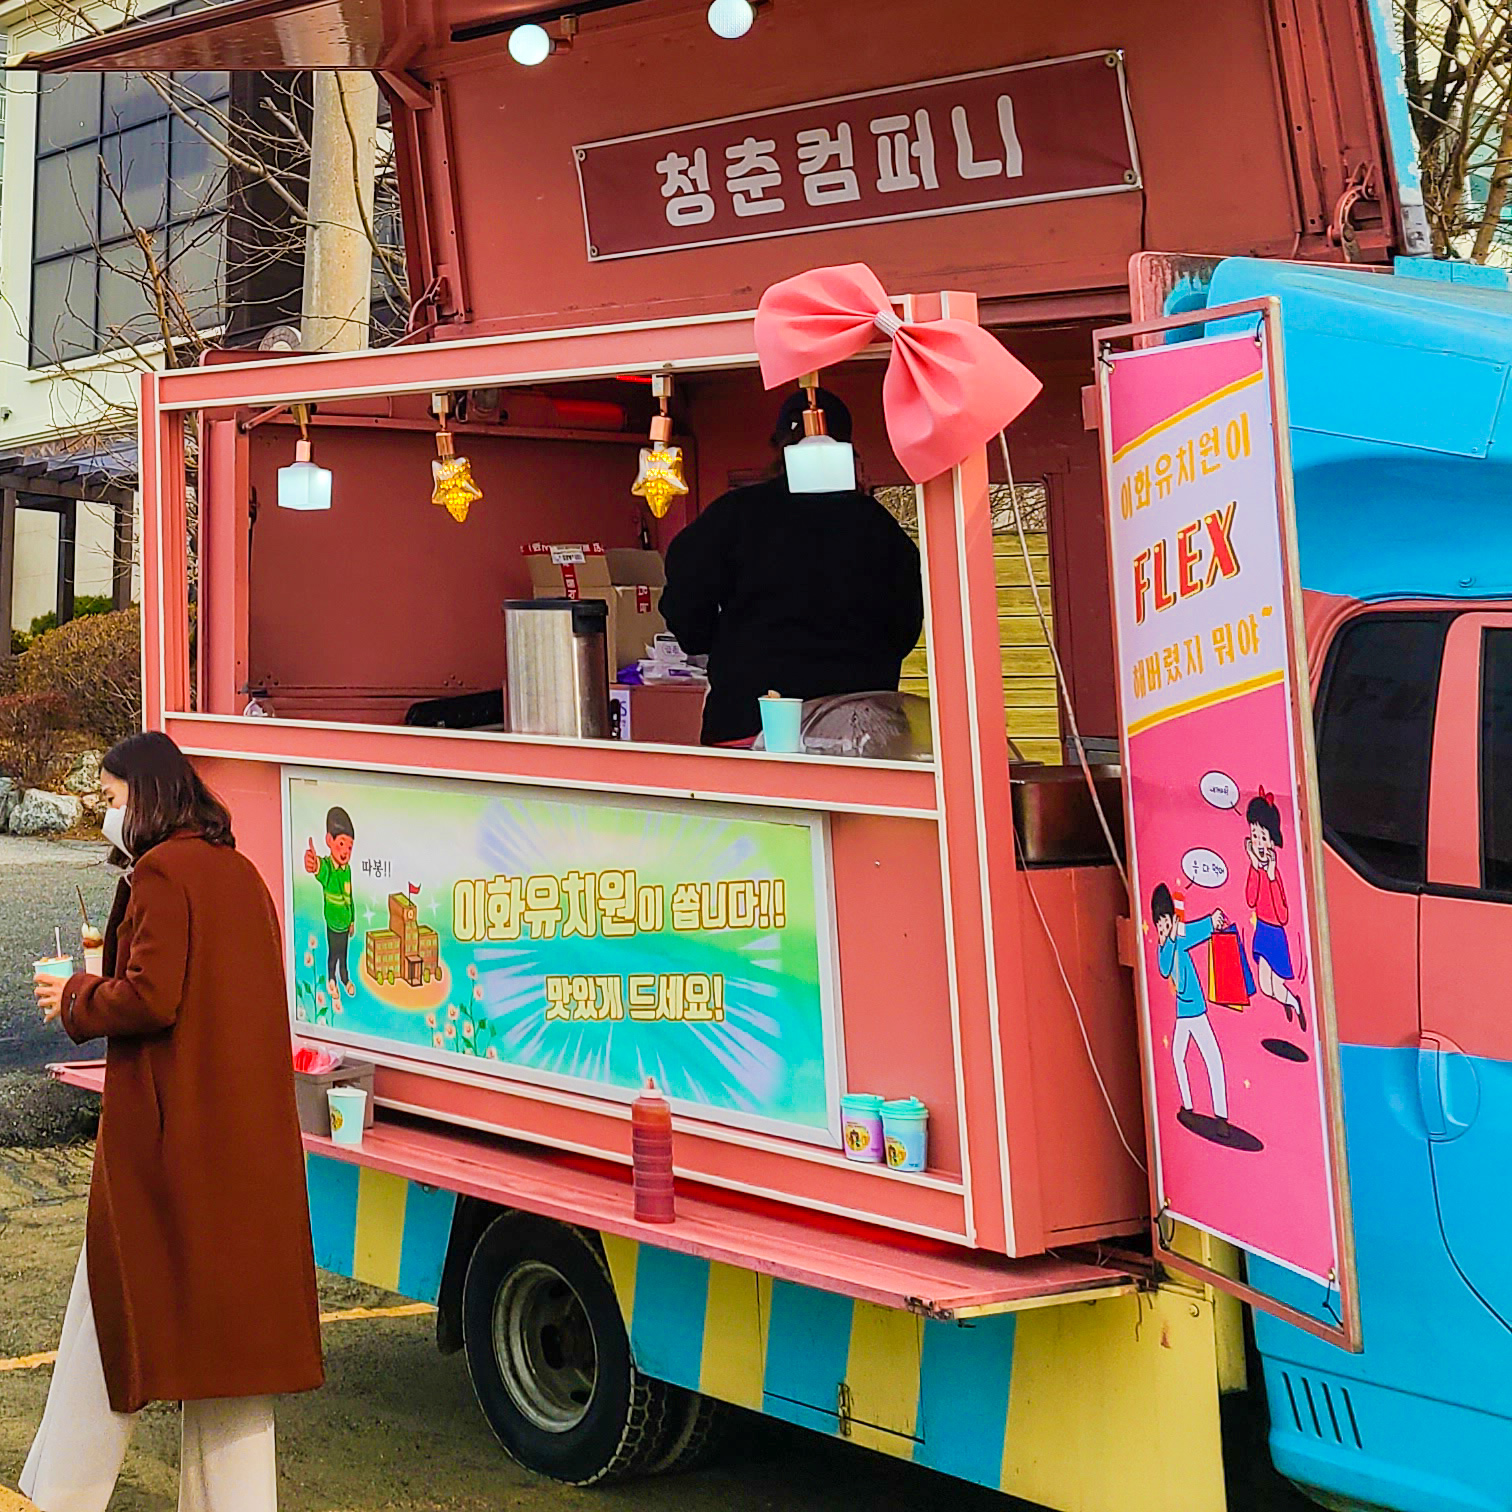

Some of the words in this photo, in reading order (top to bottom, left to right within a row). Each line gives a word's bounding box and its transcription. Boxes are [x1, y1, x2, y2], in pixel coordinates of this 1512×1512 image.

[655, 94, 1024, 228] 청춘컴퍼니
[1120, 411, 1252, 521] 이화유치원이
[1133, 501, 1241, 626] FLEX
[1132, 634, 1205, 700] 해버렸지
[362, 858, 391, 878] 따봉!!
[452, 869, 665, 942] 이화유치원이
[545, 974, 624, 1021] 맛있게
[628, 973, 725, 1022] 드세요!
